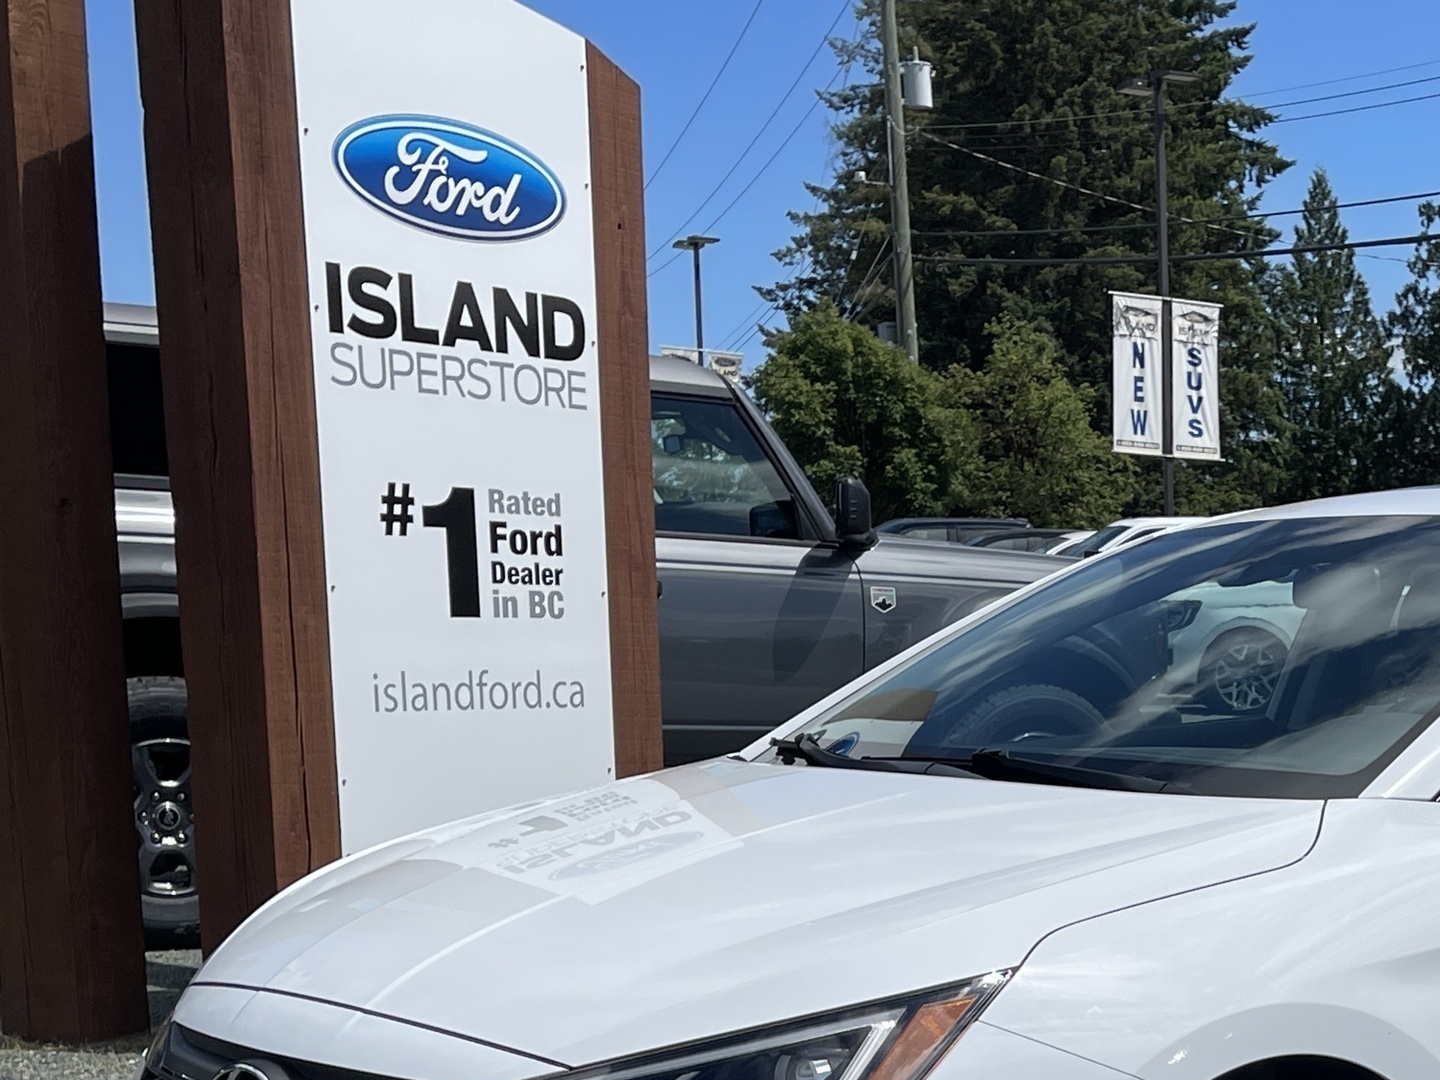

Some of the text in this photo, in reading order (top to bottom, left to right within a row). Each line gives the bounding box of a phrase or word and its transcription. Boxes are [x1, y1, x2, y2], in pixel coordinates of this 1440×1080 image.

[384, 131, 523, 225] Ford
[325, 261, 586, 361] ISLAND
[330, 342, 588, 410] SUPERSTORE
[1131, 342, 1148, 436] NEW
[1186, 347, 1204, 438] SUVS
[488, 488, 561, 517] Rated
[380, 482, 481, 618] #1
[489, 520, 563, 556] Ford
[490, 560, 564, 586] Dealer
[492, 589, 565, 619] in BC
[372, 669, 585, 712] islandford.ca
